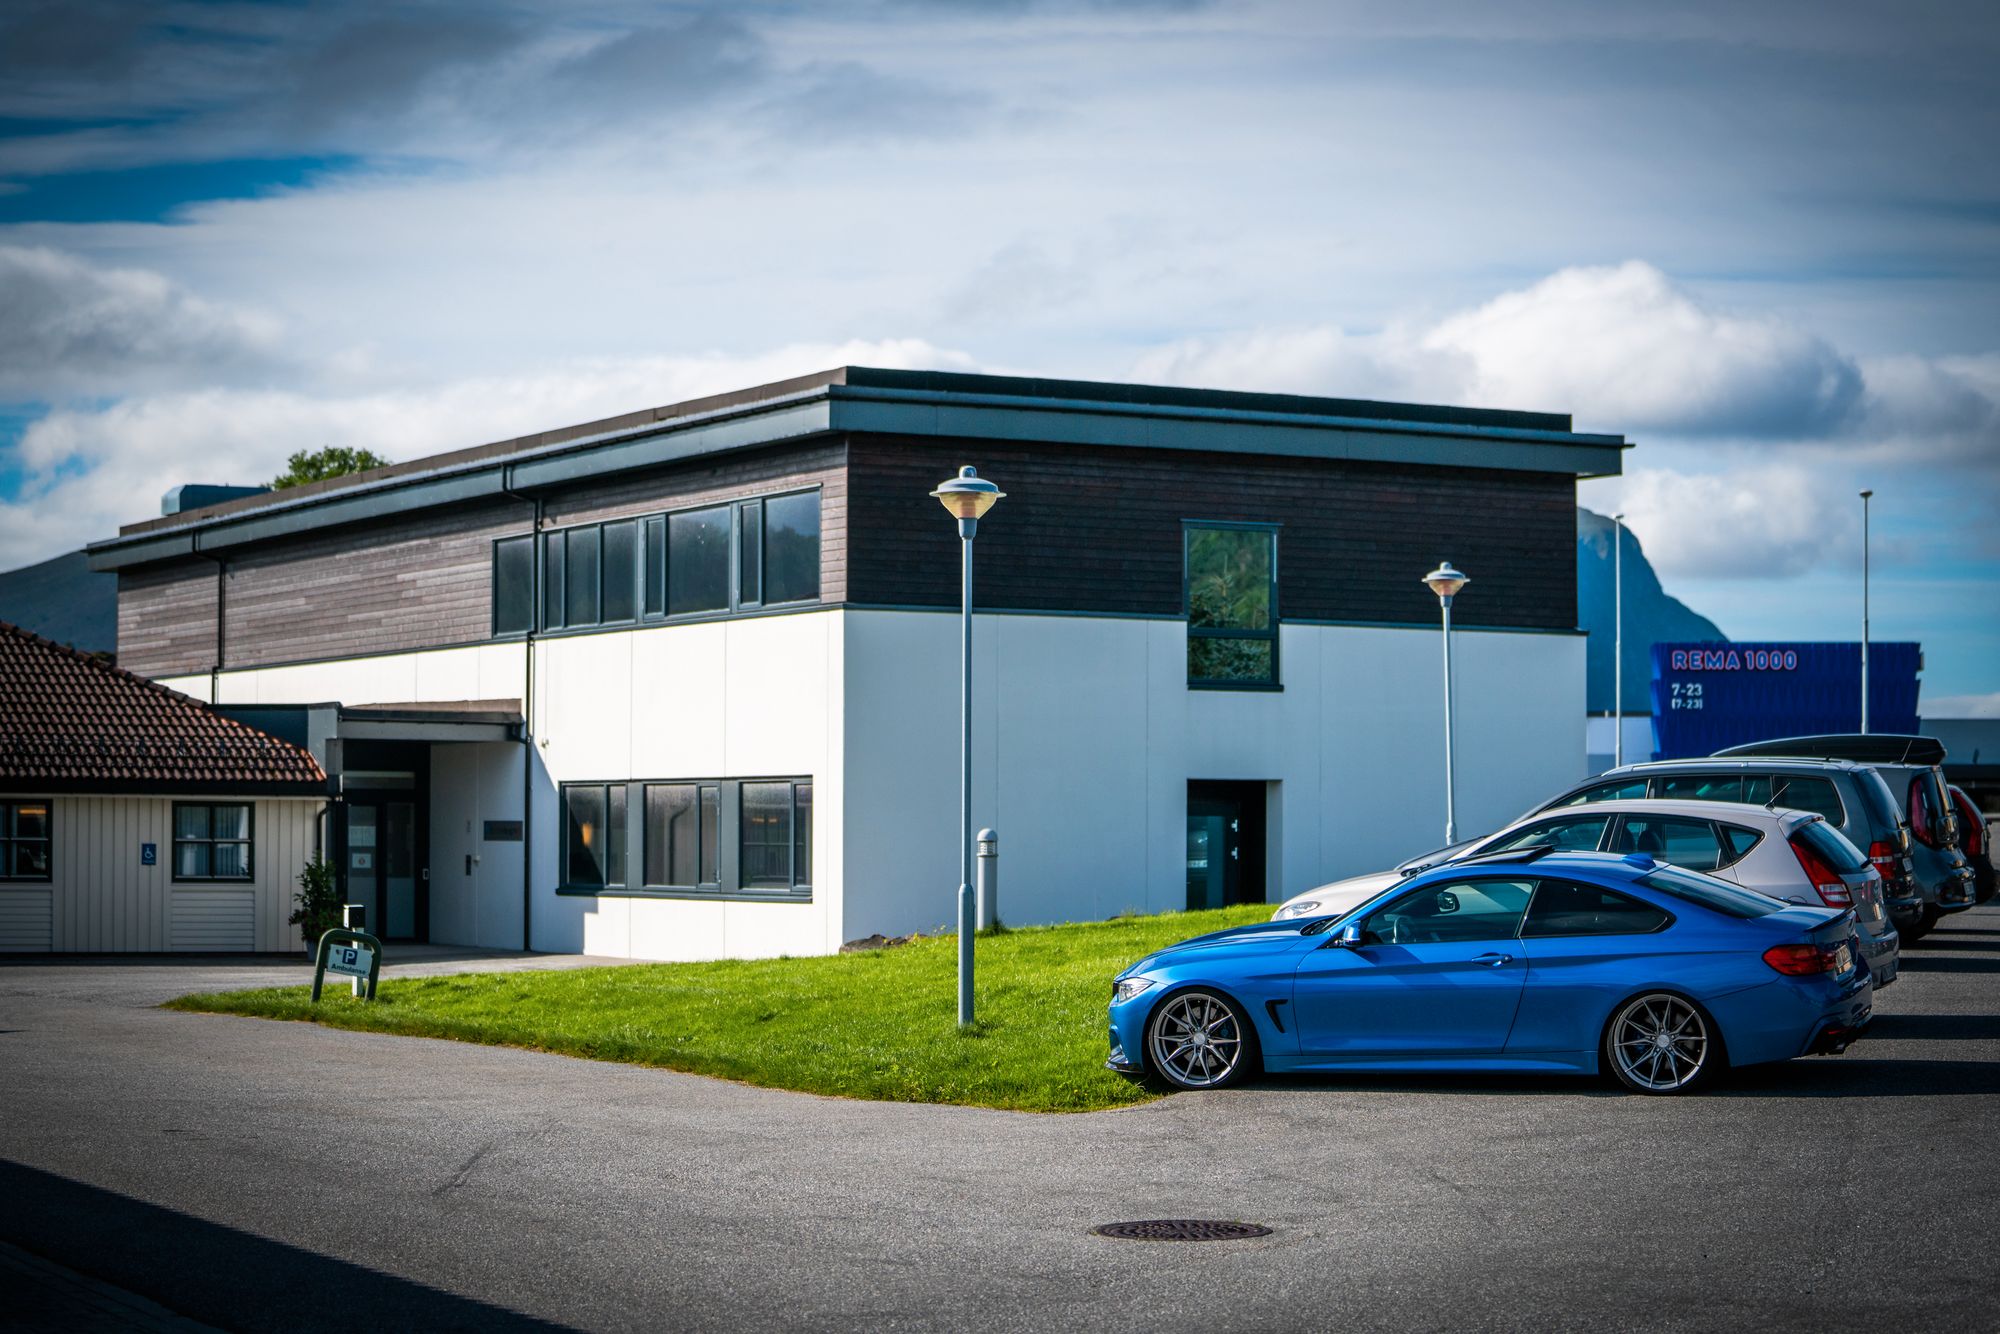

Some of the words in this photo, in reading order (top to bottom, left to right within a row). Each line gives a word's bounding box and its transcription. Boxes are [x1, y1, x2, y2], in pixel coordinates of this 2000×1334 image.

[1672, 650, 1740, 670] REMA
[1744, 650, 1797, 670] 1000
[1671, 683, 1703, 697] 7-23
[331, 963, 366, 974] Ambulanse
